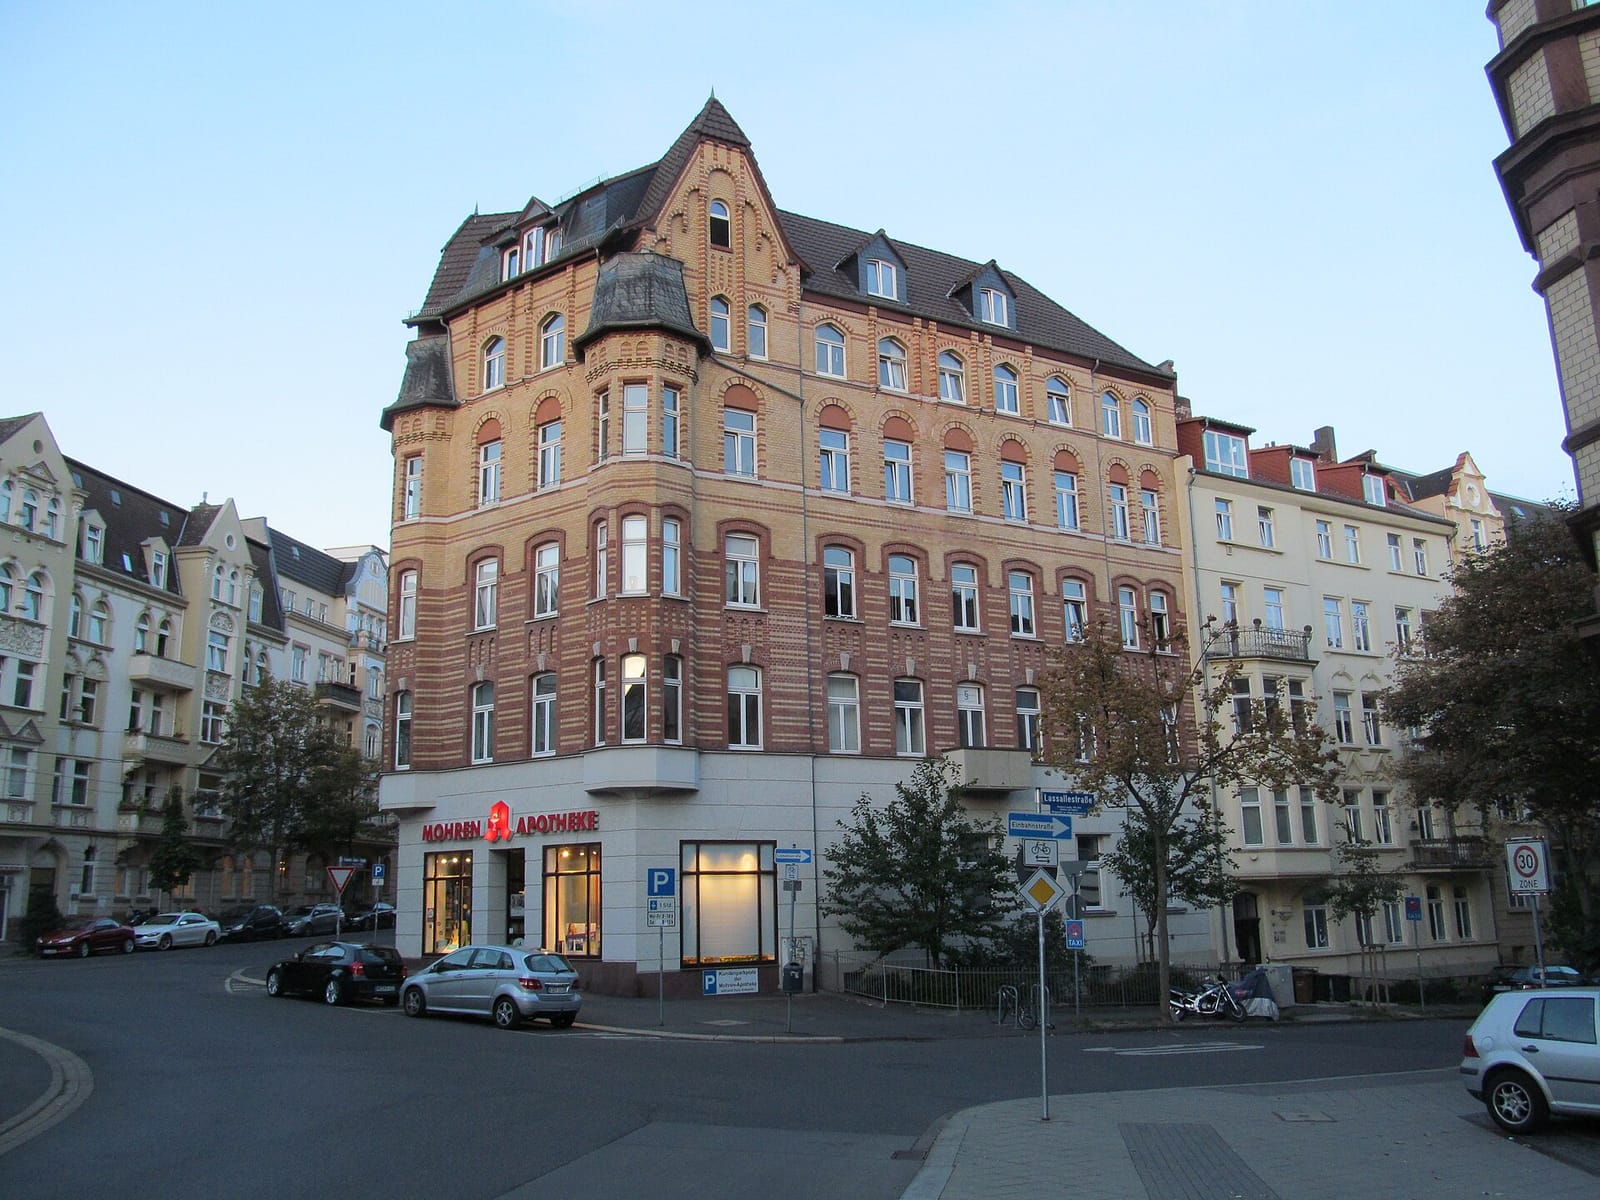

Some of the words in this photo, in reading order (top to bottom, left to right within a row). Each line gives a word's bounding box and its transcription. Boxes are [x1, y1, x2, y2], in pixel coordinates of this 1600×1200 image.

[422, 820, 481, 841] MOHREN
[516, 810, 600, 835] APOTHEKE
[1011, 821, 1054, 830] Einbahnstraße
[1518, 854, 1533, 869] 30
[375, 866, 382, 876] P
[653, 871, 669, 894] P
[1519, 879, 1539, 889] ZONE
[705, 974, 715, 990] P
